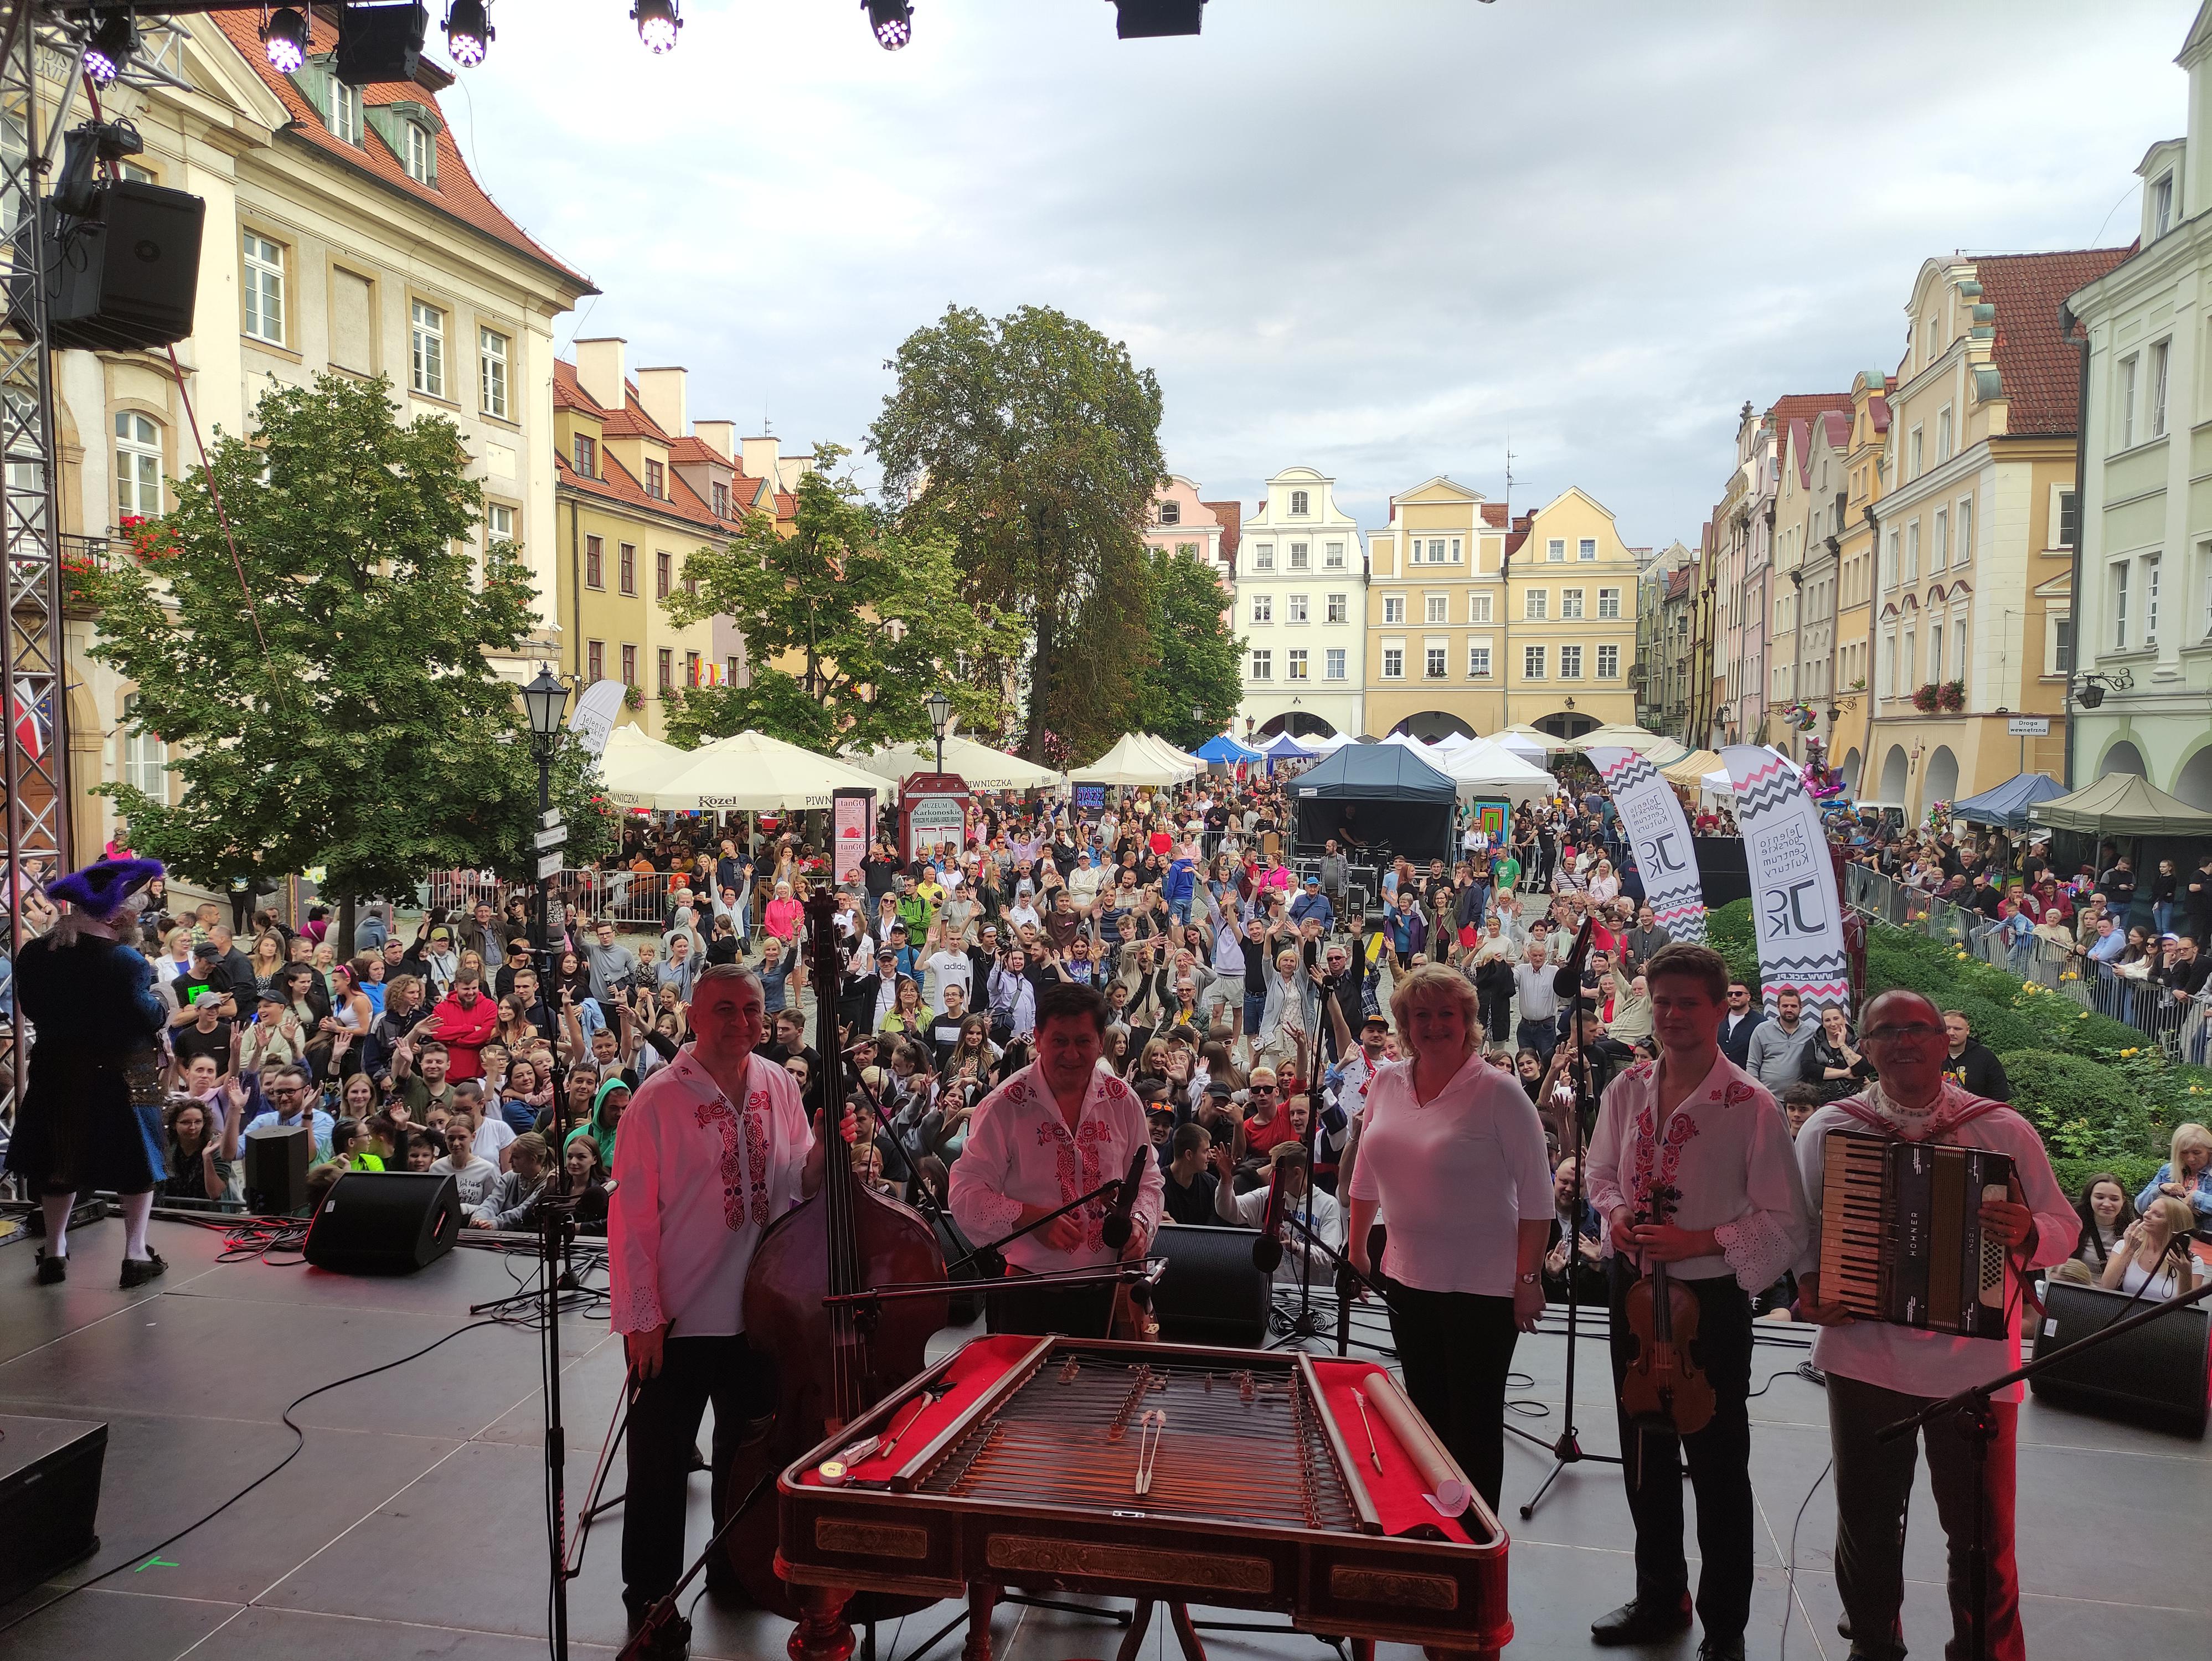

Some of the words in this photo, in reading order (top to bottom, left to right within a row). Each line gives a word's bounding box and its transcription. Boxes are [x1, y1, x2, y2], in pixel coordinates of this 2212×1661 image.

[579, 714, 605, 732] Jelenio
[582, 734, 600, 747] ntrum
[698, 796, 738, 807] Kozel
[806, 796, 832, 806] PIWN
[1910, 1212, 1918, 1257] HOHNER
